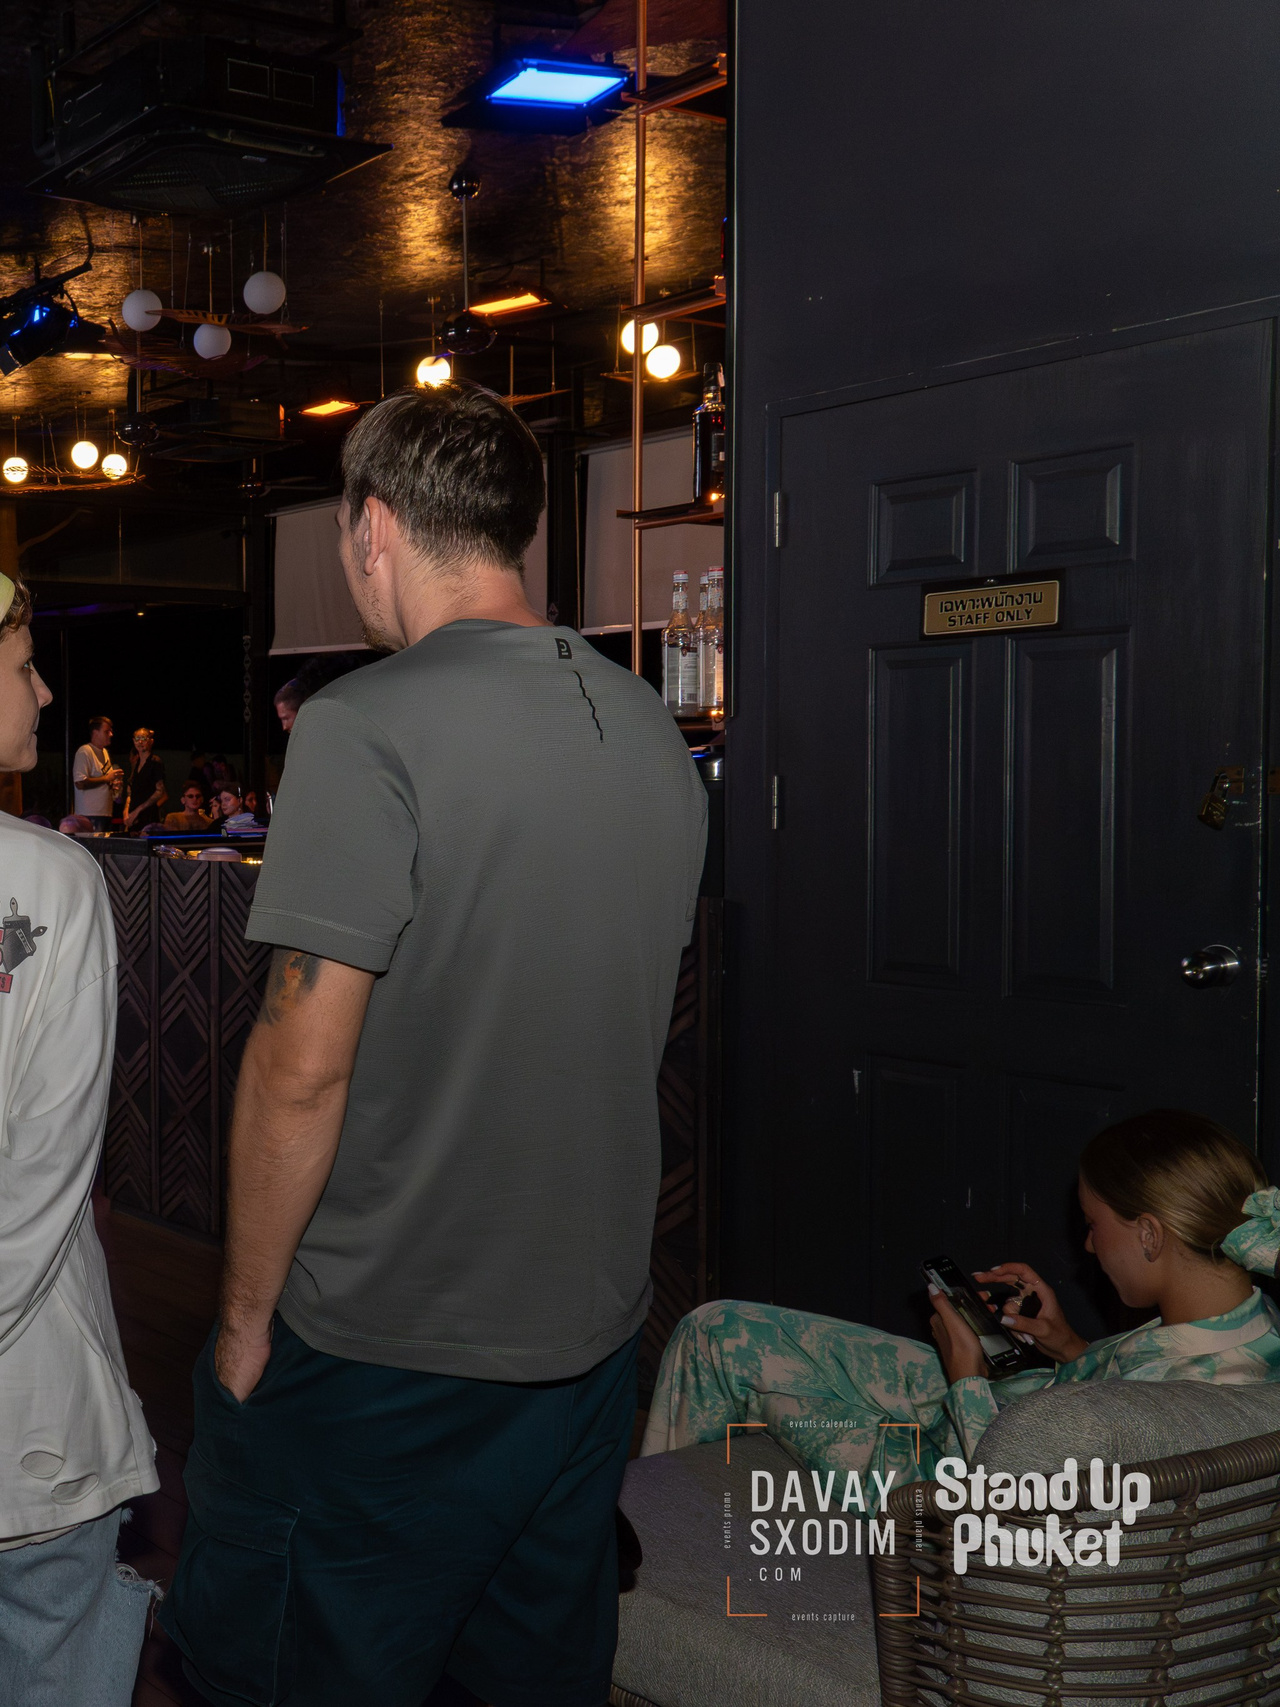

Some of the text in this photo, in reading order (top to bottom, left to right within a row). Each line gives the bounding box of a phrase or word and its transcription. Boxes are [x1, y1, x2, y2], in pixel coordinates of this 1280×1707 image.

[940, 591, 1043, 614] เฉพาะพนักงาน
[947, 608, 1033, 627] STAFF ONLY
